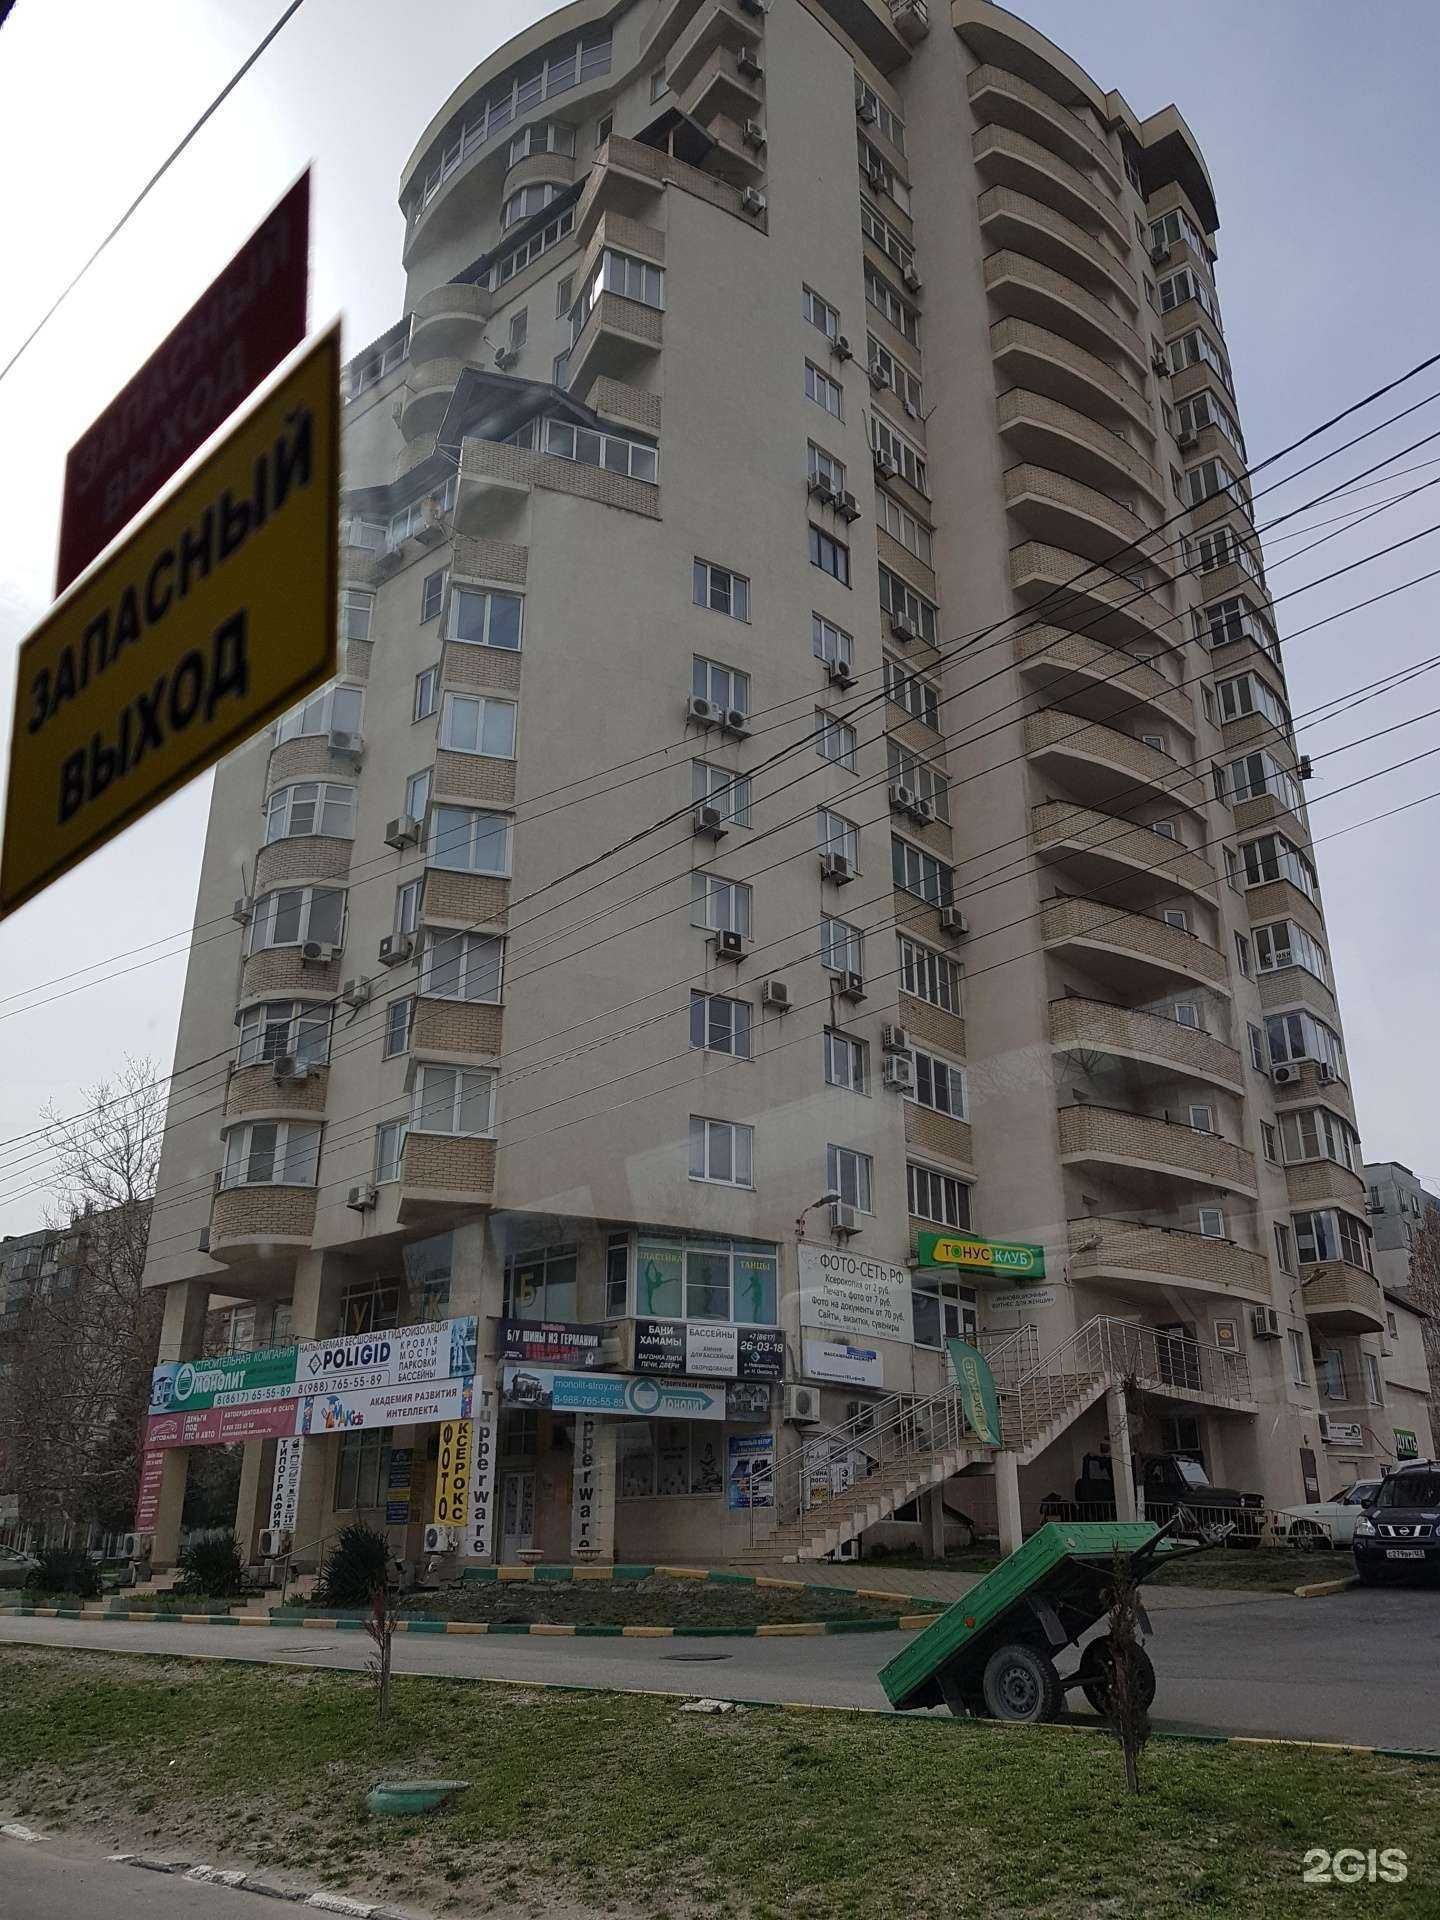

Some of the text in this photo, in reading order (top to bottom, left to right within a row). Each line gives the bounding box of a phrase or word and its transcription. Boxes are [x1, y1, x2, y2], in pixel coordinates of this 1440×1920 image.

[29, 405, 313, 735] ЗАПАСНЫЙ
[58, 605, 249, 824] ВЫХОД
[942, 1243, 1028, 1265] ТОНУС КЛУБ
[820, 1254, 904, 1285] ФОТО-СЕТЬ.РФ
[825, 1274, 862, 1289] Ксерокопия
[823, 1285, 846, 1298] Печать
[811, 1296, 828, 1307] Фото
[840, 1303, 874, 1316] документы
[345, 1333, 387, 1348] БЕСШОВНАЯ
[388, 1322, 449, 1342] ГИДРОИЗОЛЯЦИЯ
[648, 1325, 674, 1335] БАНИ
[689, 1328, 735, 1340] БАССЕЙНЫ
[400, 1337, 439, 1352] КРОВЛЯ
[507, 1329, 599, 1347] Б/У ШИНЫ ИЗ ГЕРМАНИИ
[639, 1335, 682, 1347] ХАМАМЫ
[399, 1347, 437, 1361] МОСТЫ
[740, 1340, 784, 1353] 26-03-18
[195, 1353, 251, 1372] СТРОИТЕЛЬНАЯ
[323, 1342, 390, 1371] POLIGID
[398, 1357, 438, 1371] ПАРКОВКИ
[398, 1368, 437, 1383] БАССЕЙНЫ
[298, 1374, 382, 1395] 8(988) 765-55-89
[554, 1379, 623, 1394] monolit-stroy.net
[251, 1386, 291, 1401] 65-55-89
[369, 1388, 458, 1409] АКАДЕМИЯ РАЗВИТИЯ
[185, 1413, 207, 1424] ДЕНЬГИ
[386, 1404, 440, 1419] ИНТЕЛЛЕКТА
[185, 1423, 199, 1434] ПОД
[200, 1429, 216, 1440] АВТО
[439, 1423, 453, 1521] ФОТО
[452, 1422, 469, 1520] КСЕРОКС
[273, 1440, 288, 1529] ТИПОГРАФИЯ
[578, 1413, 594, 1548] pperware
